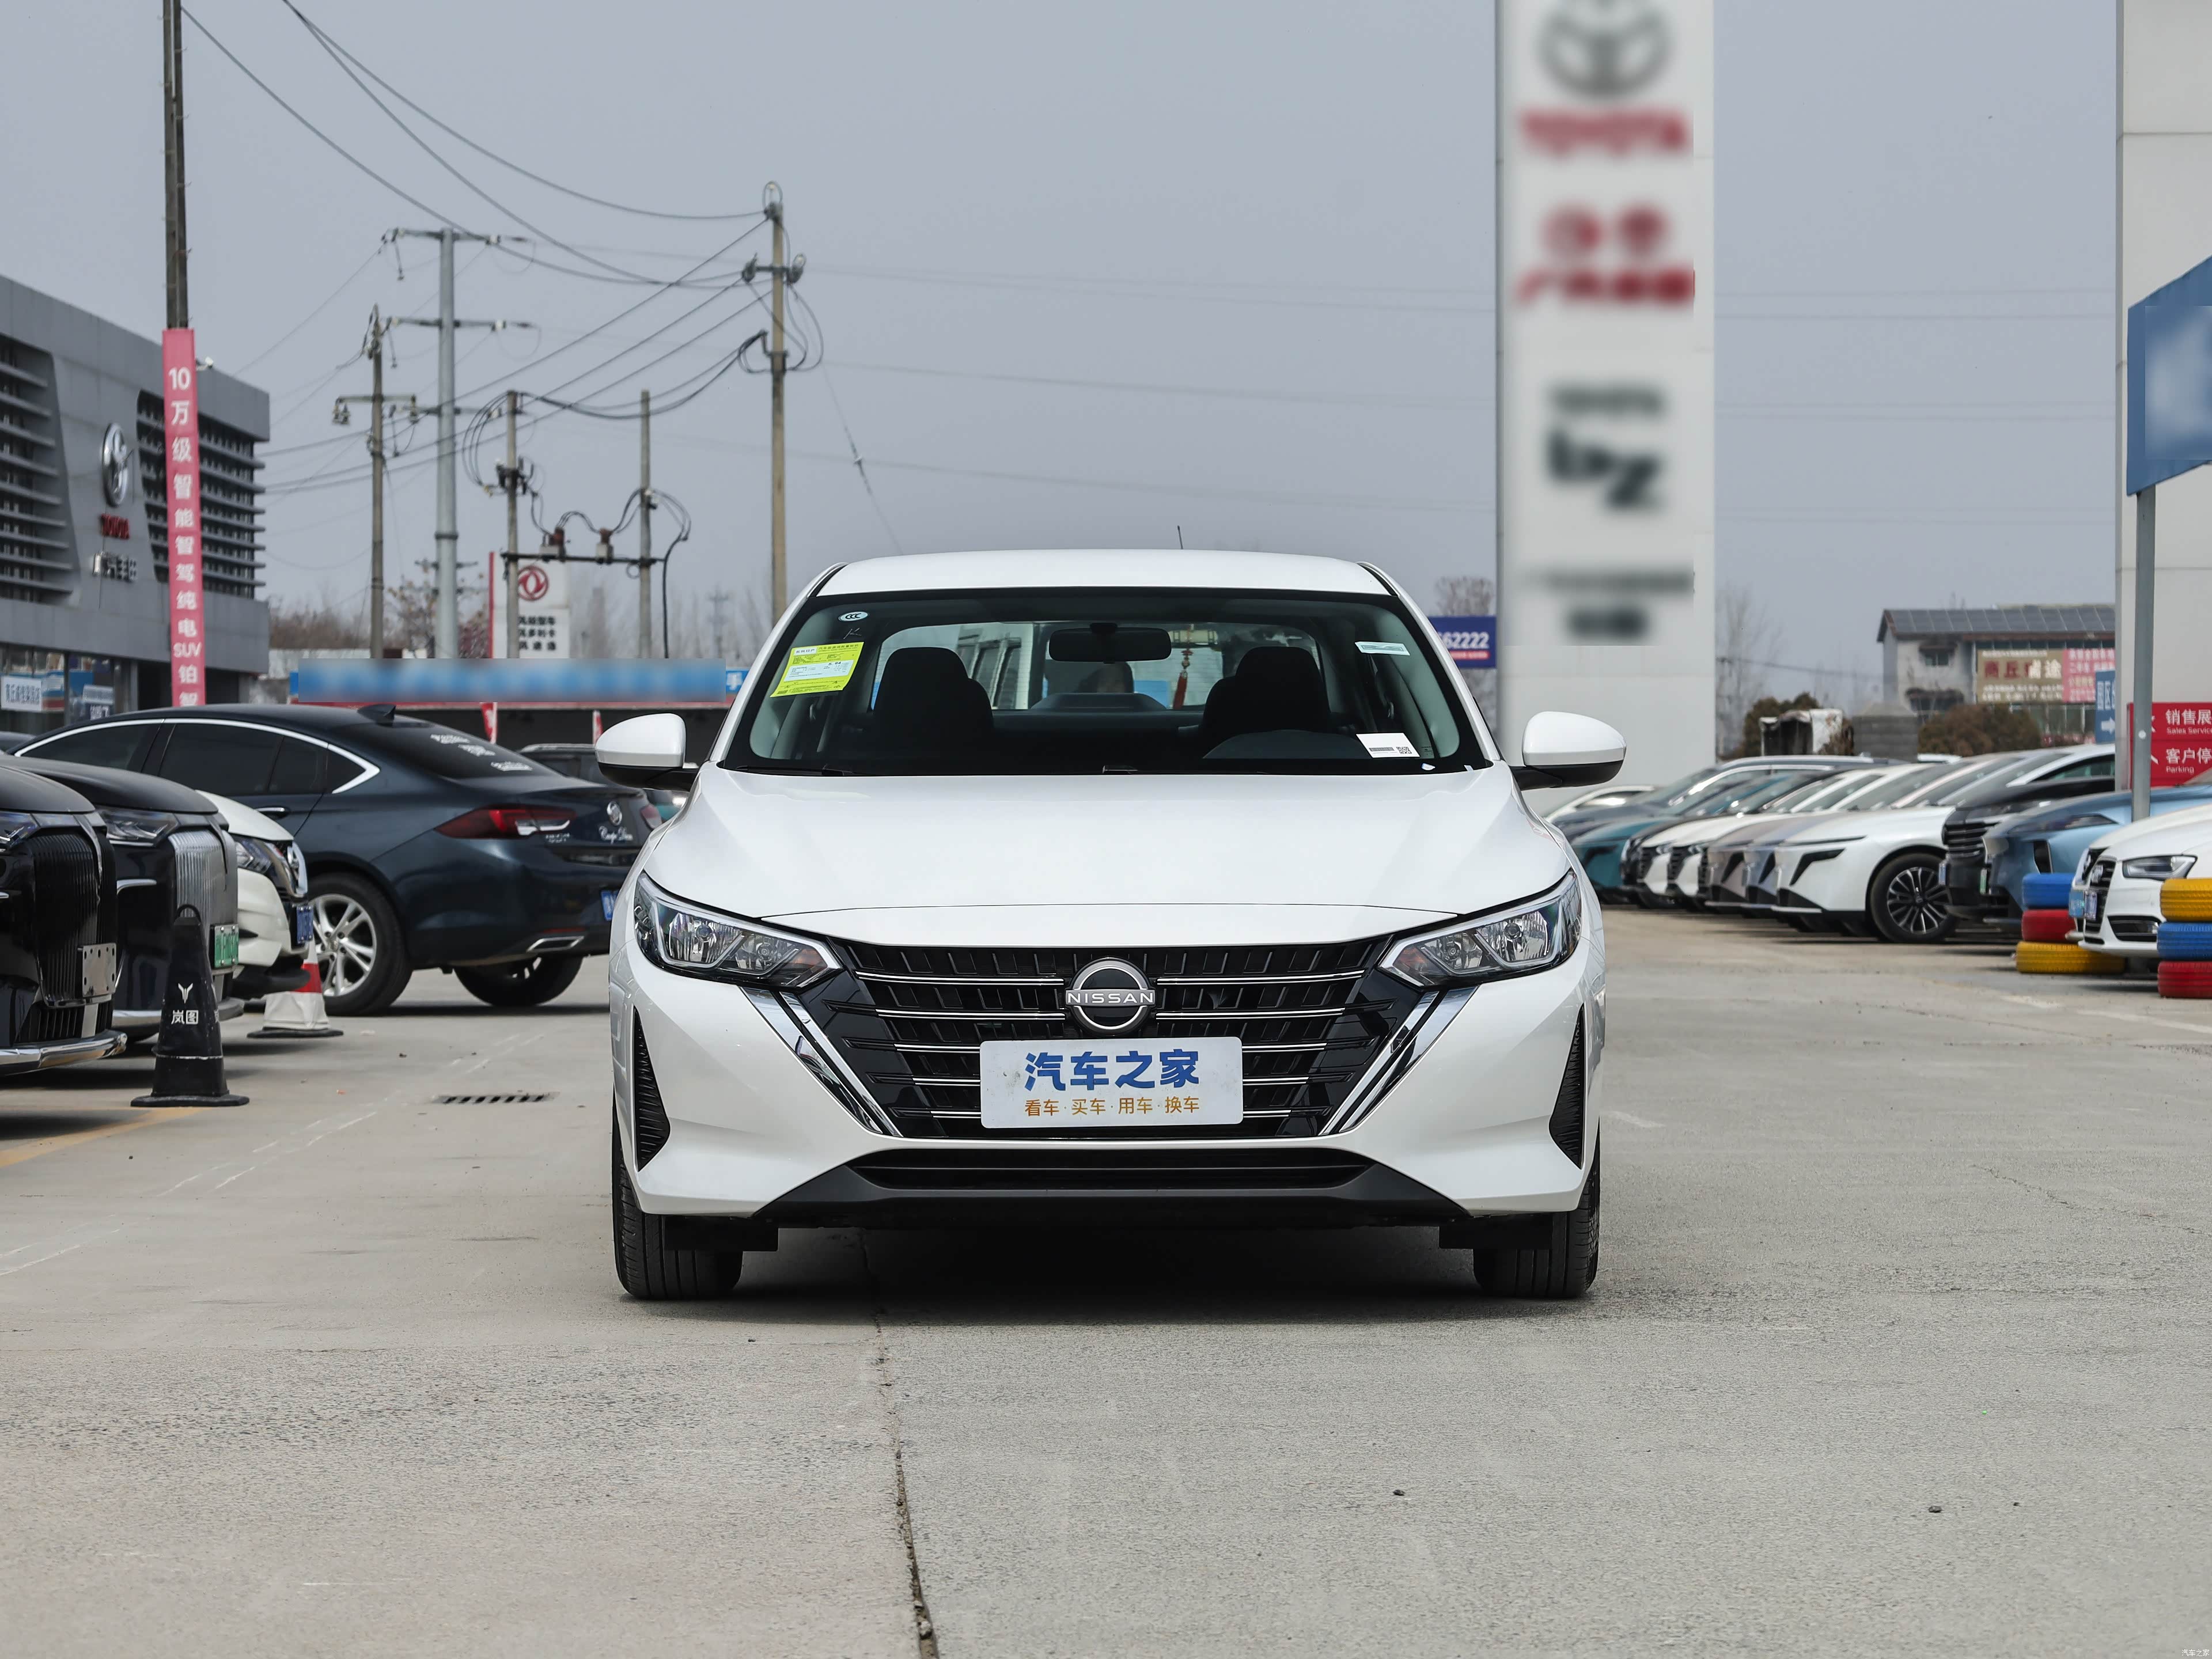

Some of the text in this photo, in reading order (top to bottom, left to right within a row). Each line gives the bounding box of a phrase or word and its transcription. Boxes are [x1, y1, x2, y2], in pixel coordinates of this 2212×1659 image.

[1438, 631, 1490, 649] 62222
[2165, 709, 2212, 726] 销售展
[2166, 727, 2187, 735] Sales
[2166, 747, 2212, 764] 客户停
[2166, 766, 2195, 774] Parking
[1067, 993, 1153, 1003] NISSAN
[171, 1010, 199, 1024] 岚图
[1024, 1048, 1199, 1092] 汽车之家
